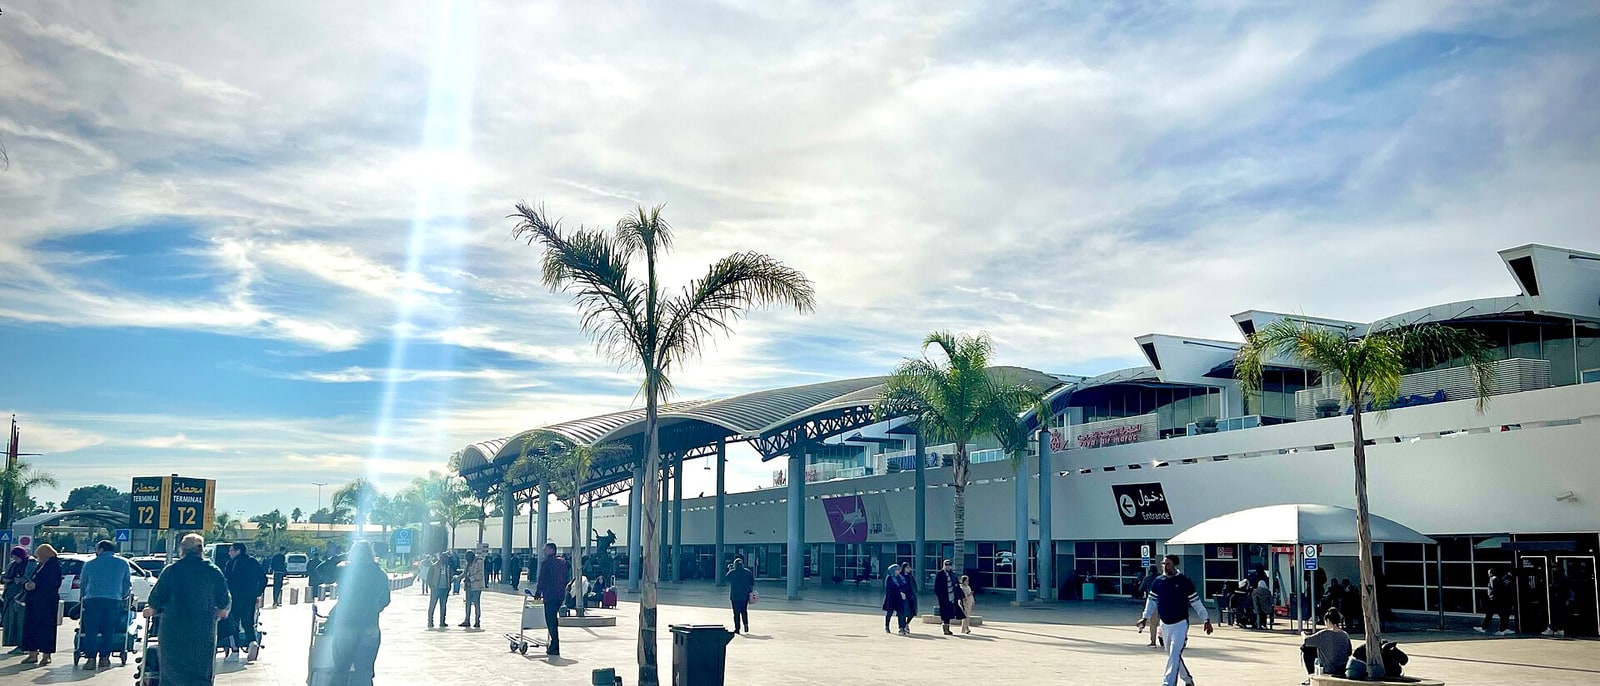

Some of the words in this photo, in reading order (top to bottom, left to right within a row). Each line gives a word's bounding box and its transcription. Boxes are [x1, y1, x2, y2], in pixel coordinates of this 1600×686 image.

[133, 482, 159, 494] محطة
[173, 482, 203, 494] محطة
[173, 495, 202, 503] TERMINAL
[1138, 489, 1164, 506] دخول
[138, 506, 154, 524] T2
[177, 507, 196, 525] T2
[1141, 511, 1170, 520] Entrance
